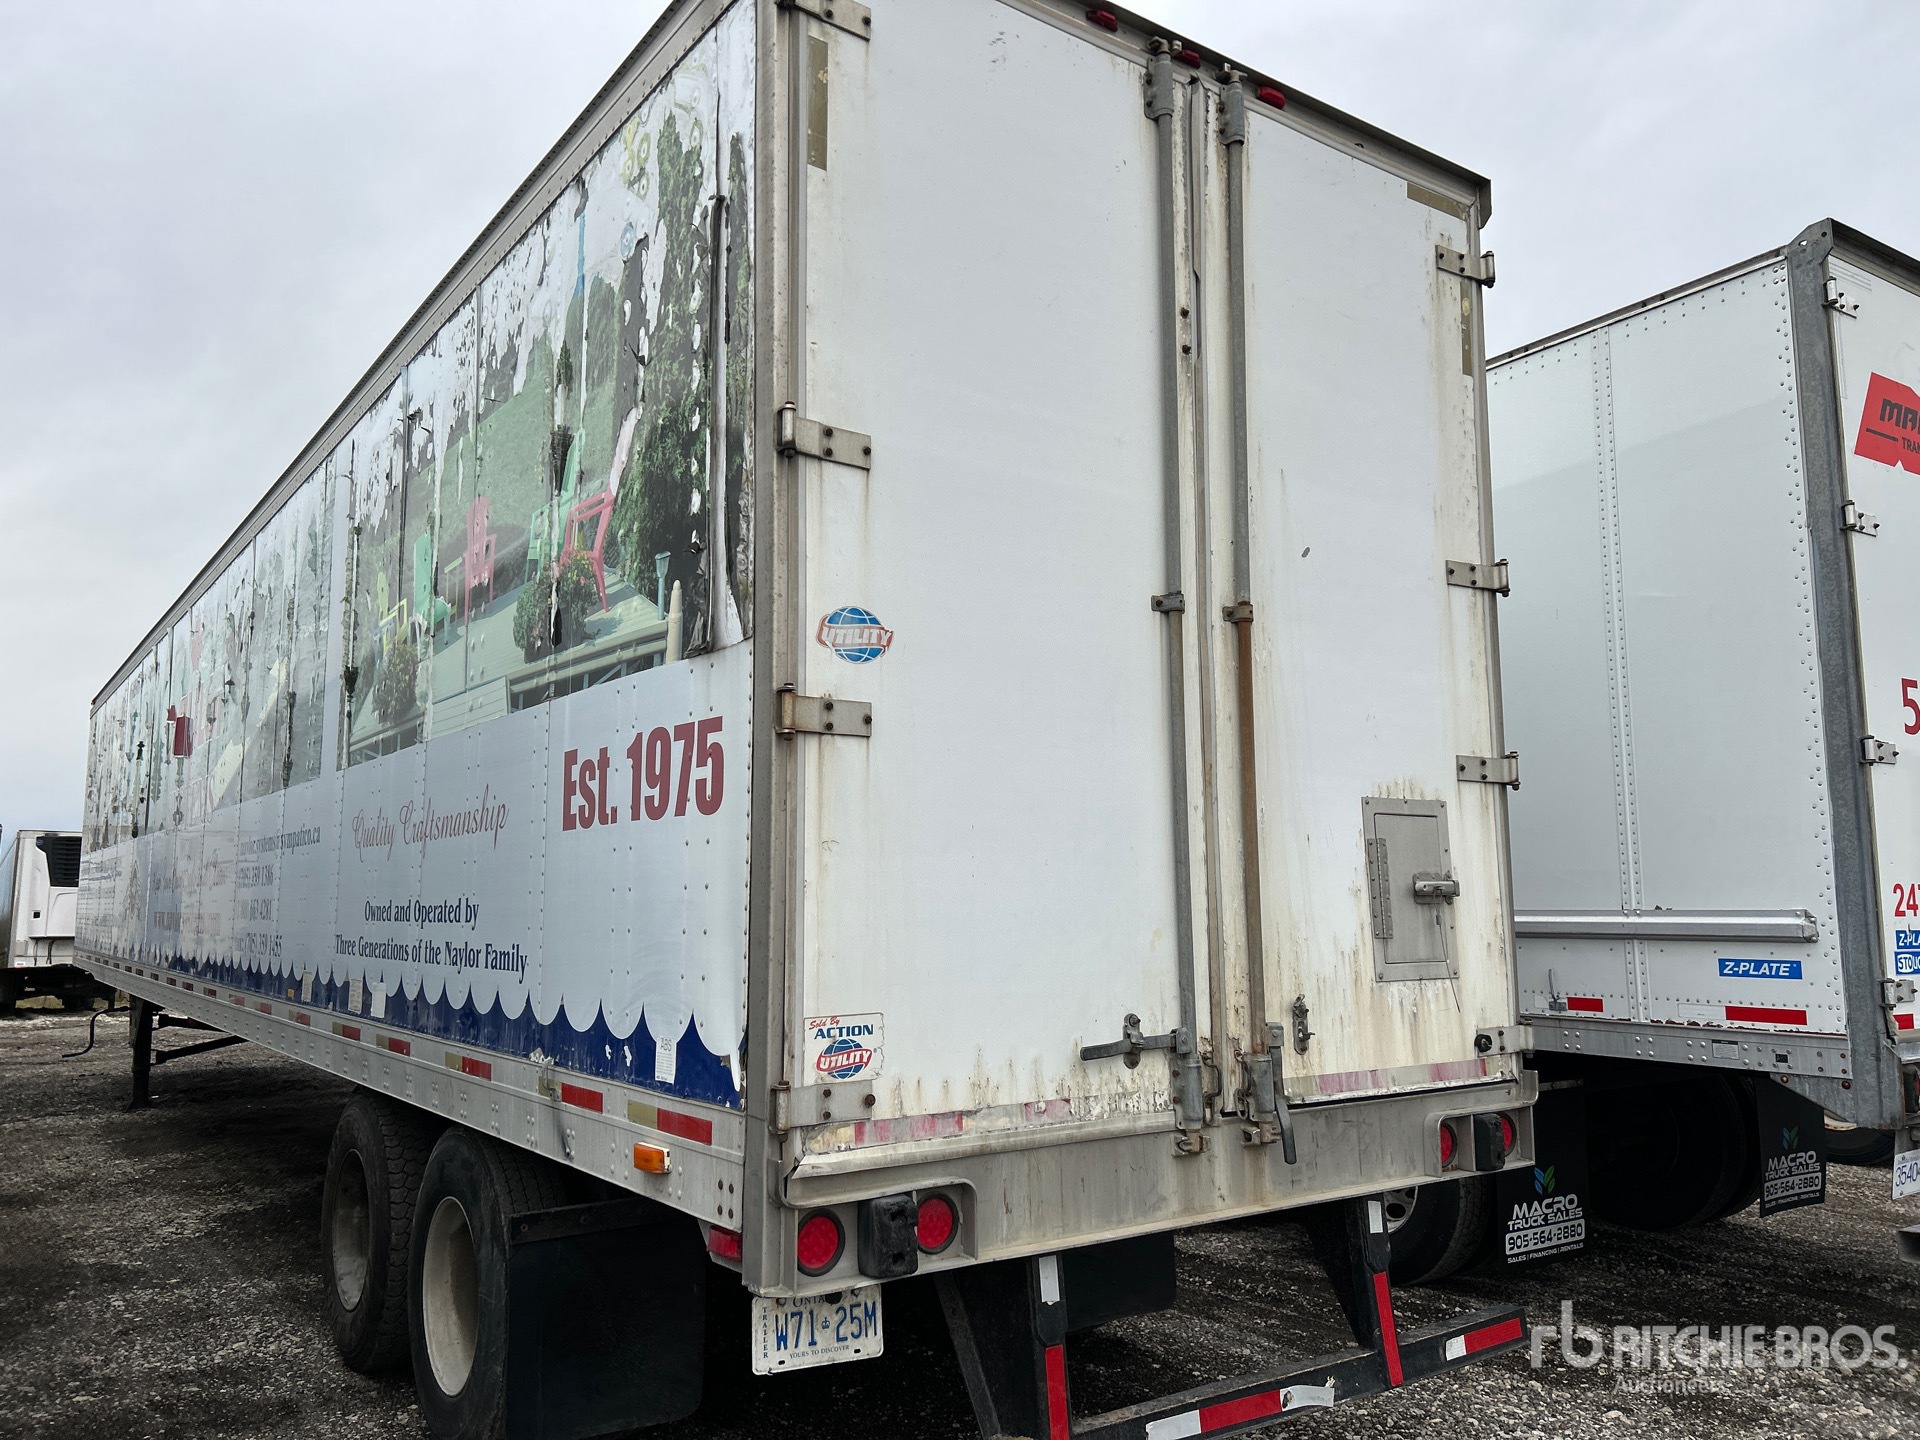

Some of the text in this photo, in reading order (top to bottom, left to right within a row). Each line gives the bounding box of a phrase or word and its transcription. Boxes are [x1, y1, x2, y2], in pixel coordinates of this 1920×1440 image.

[1879, 398, 1920, 436] MA
[821, 625, 892, 648] UTILITY
[562, 715, 725, 832] Est. 1975
[352, 784, 510, 863] Quality Craftsmanship
[1893, 883, 1920, 917] 24
[364, 897, 480, 931] Owned and Operated by
[335, 935, 528, 984] Three Generations of the Naylor Family
[1723, 961, 1791, 976] Z-PLATE
[809, 1015, 840, 1030] Sold By
[814, 1024, 873, 1039] ACTION
[819, 1050, 871, 1069] UTILITY
[1765, 1162, 1820, 1180] TRUCK SALES
[1768, 1150, 1816, 1171] MACRO
[1765, 1175, 1820, 1198] 905-564-2880
[1896, 1162, 1920, 1187] 3540
[1512, 1193, 1578, 1220] MACRO
[1507, 1207, 1583, 1231] TRUCK SALES
[1507, 1222, 1583, 1251] 905-564-2880
[1507, 1242, 1584, 1264] SALES FINANCING RENTALS
[775, 1300, 878, 1352] W71 25M
[789, 1344, 850, 1359] YOURS TO DISCOVER
